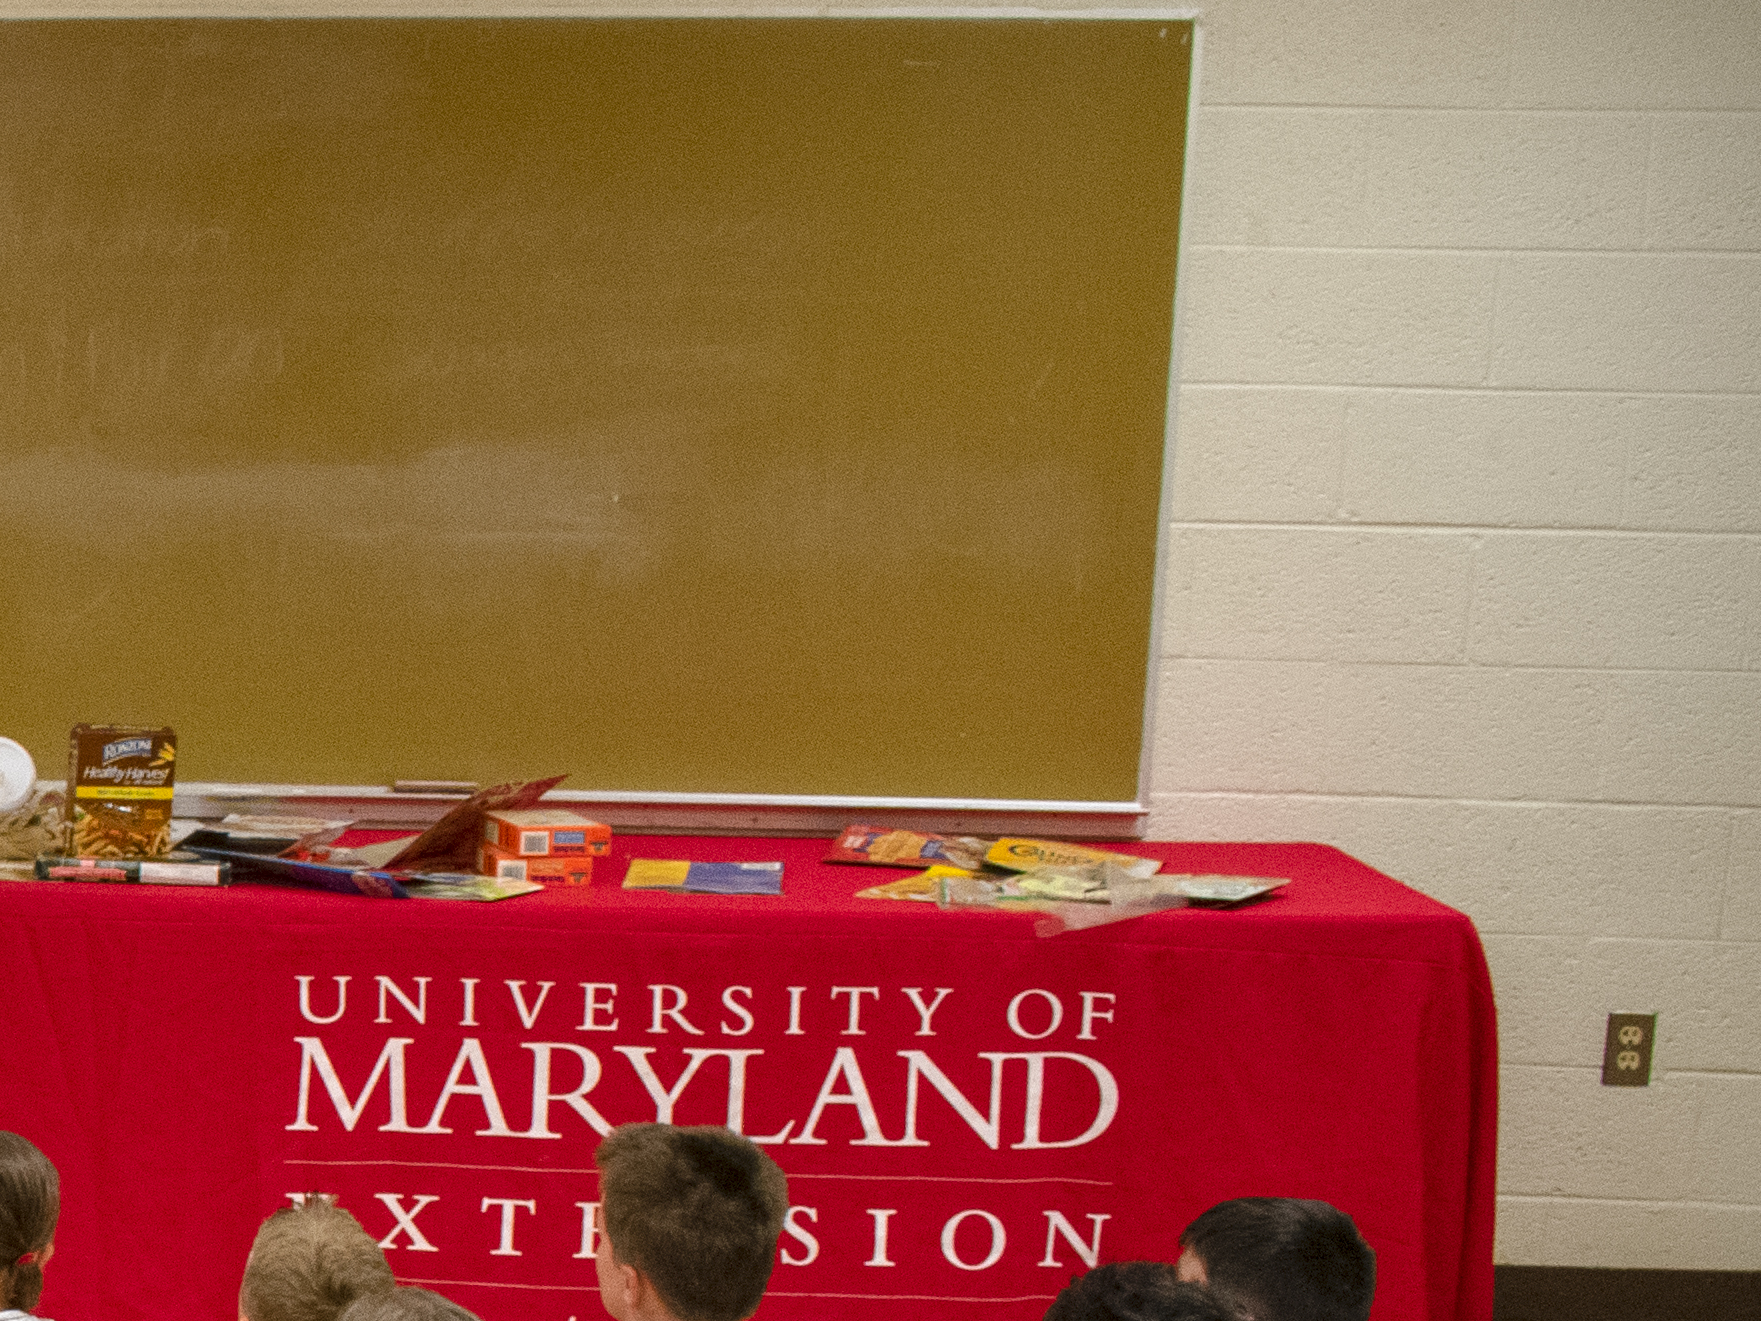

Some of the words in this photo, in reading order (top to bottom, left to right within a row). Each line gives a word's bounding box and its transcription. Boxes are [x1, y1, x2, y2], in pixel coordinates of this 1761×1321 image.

[294, 974, 955, 1038] UNIVERSITY
[1006, 988, 1117, 1042] OF
[284, 1036, 1120, 1152] MARYLAND
